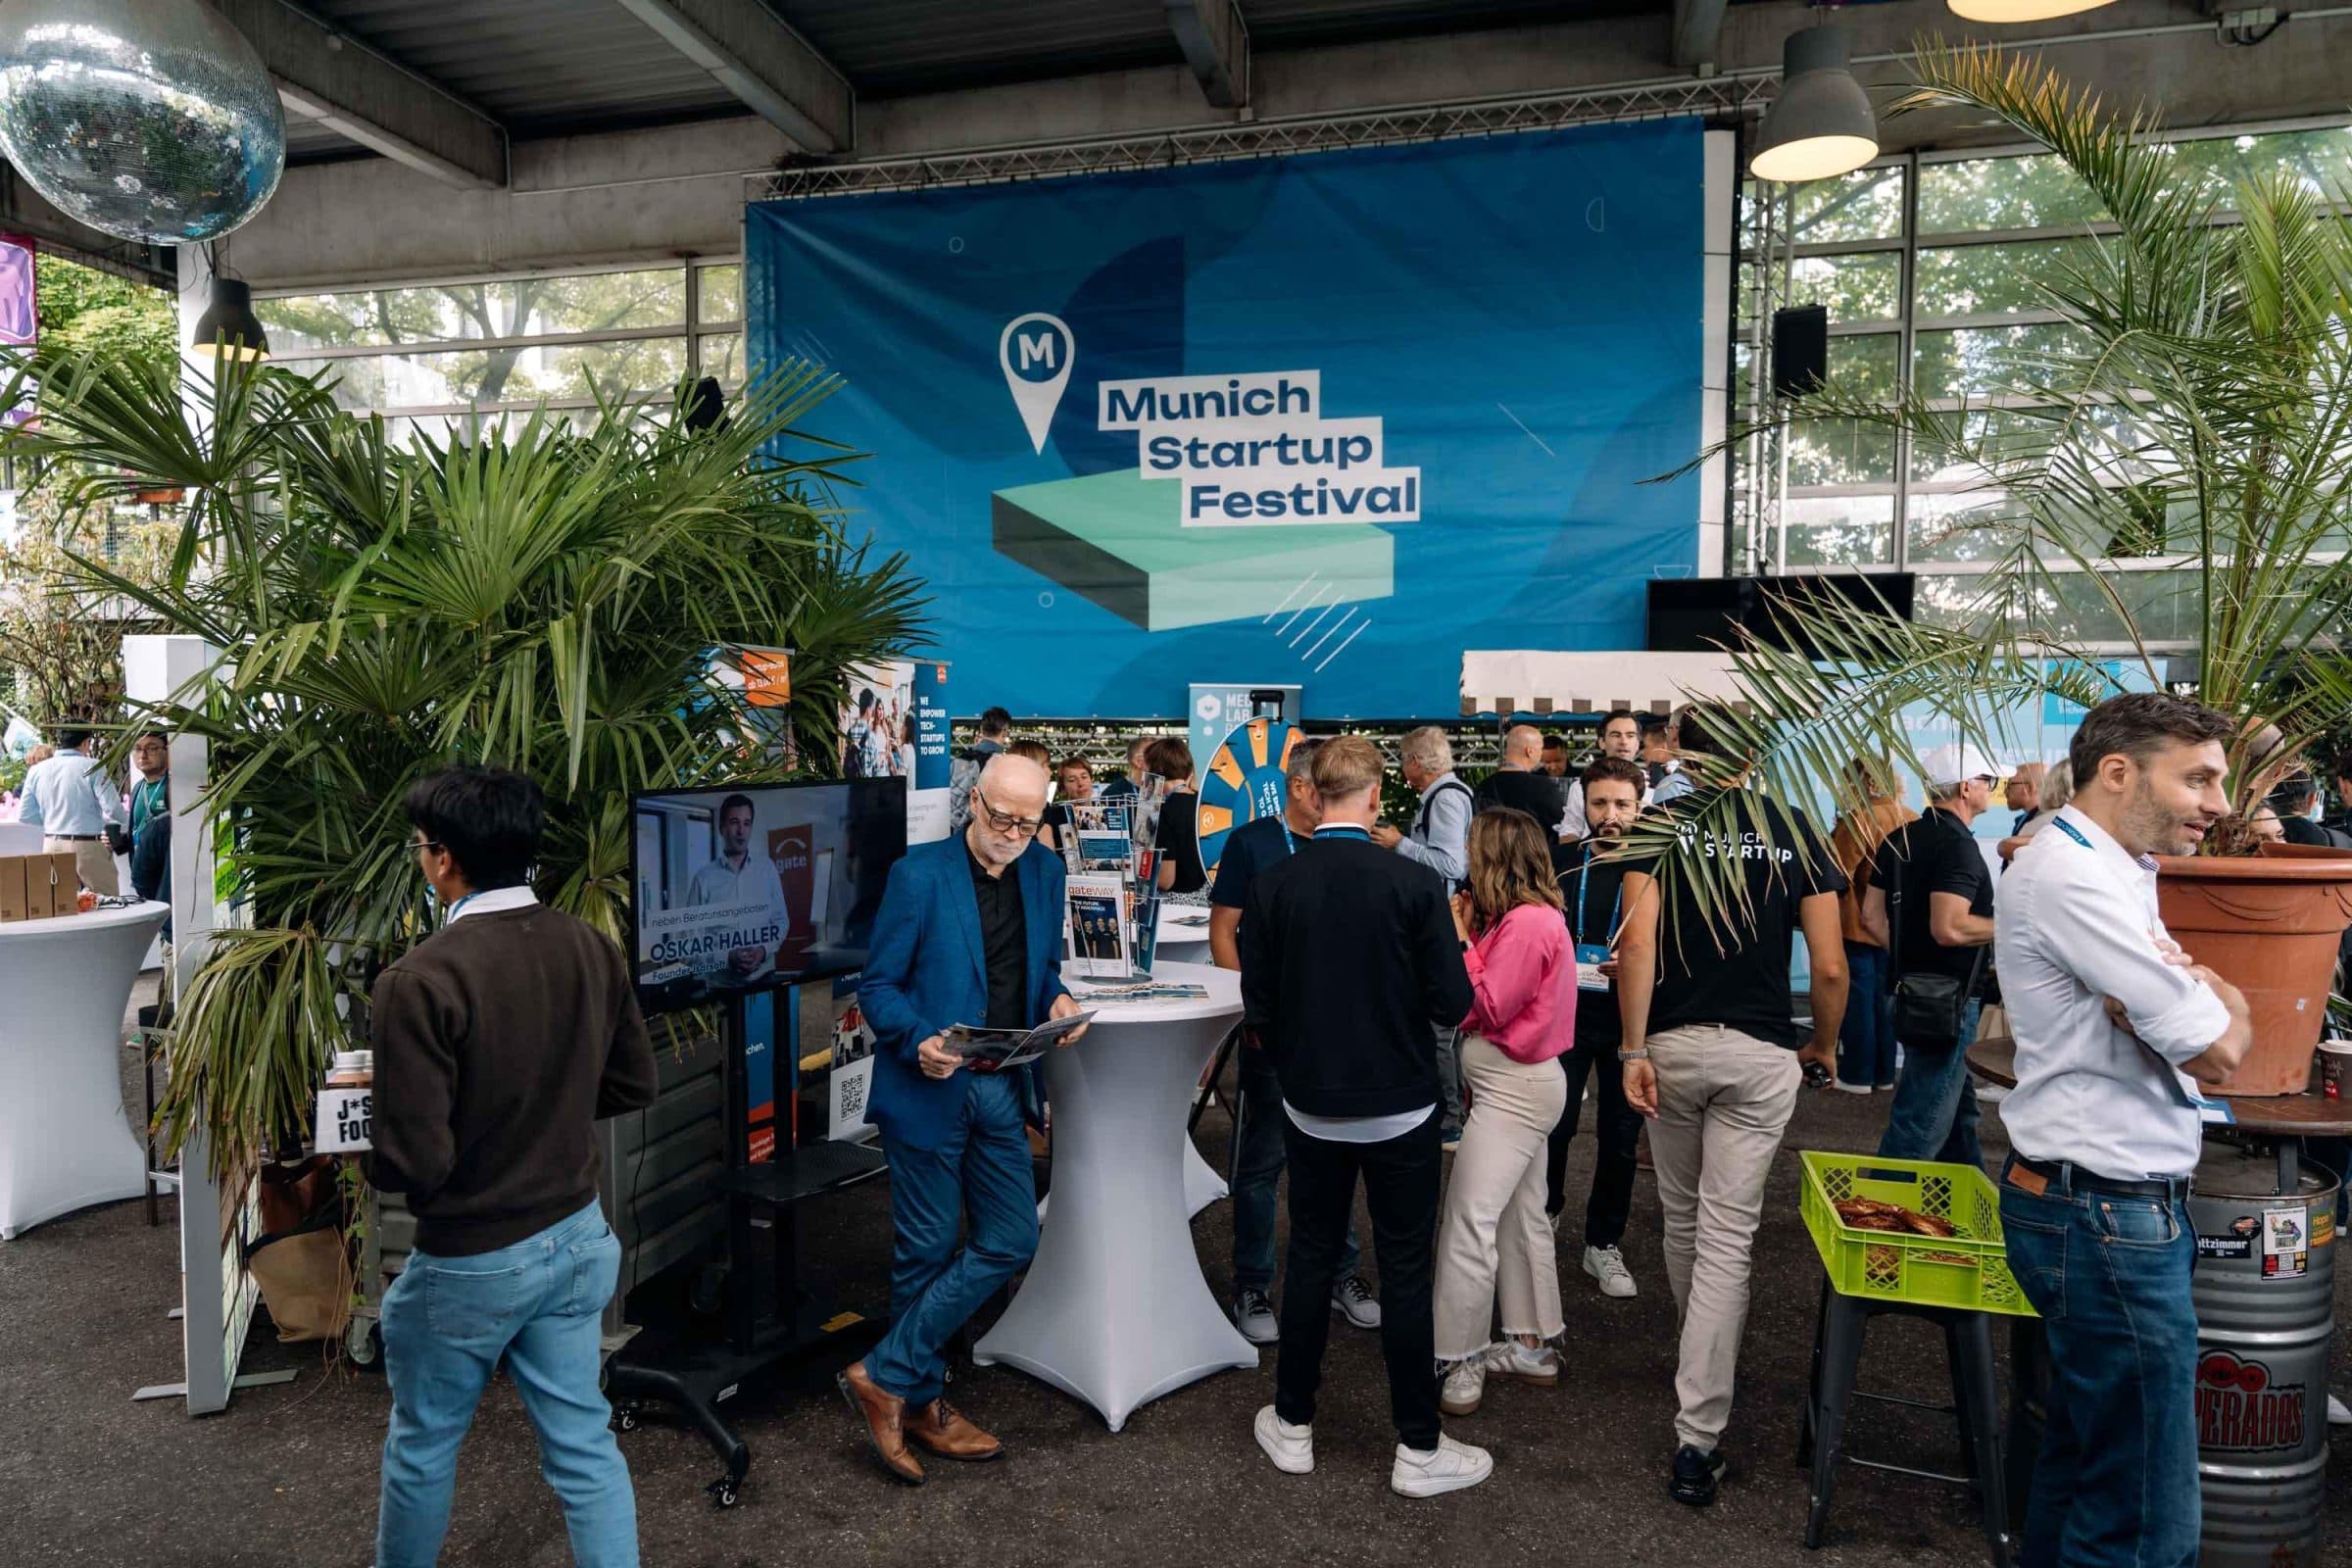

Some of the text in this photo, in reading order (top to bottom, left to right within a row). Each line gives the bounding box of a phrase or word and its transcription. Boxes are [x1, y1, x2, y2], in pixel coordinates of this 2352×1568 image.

[1018, 333, 1054, 369] M
[1107, 379, 1310, 422] Munich
[1148, 433, 1373, 470] Startup
[1190, 477, 1417, 519] Festival
[920, 697, 929, 706] WE
[920, 709, 946, 718] EMPOWER
[1226, 709, 1251, 722] LAB
[920, 733, 946, 743] STARTUPS
[920, 745, 946, 756] TO GROW
[1704, 830, 1763, 844] MUICH
[1705, 843, 1792, 862] SARTP
[650, 924, 780, 961] OSKAR HALLER
[338, 1118, 372, 1143] FOO
